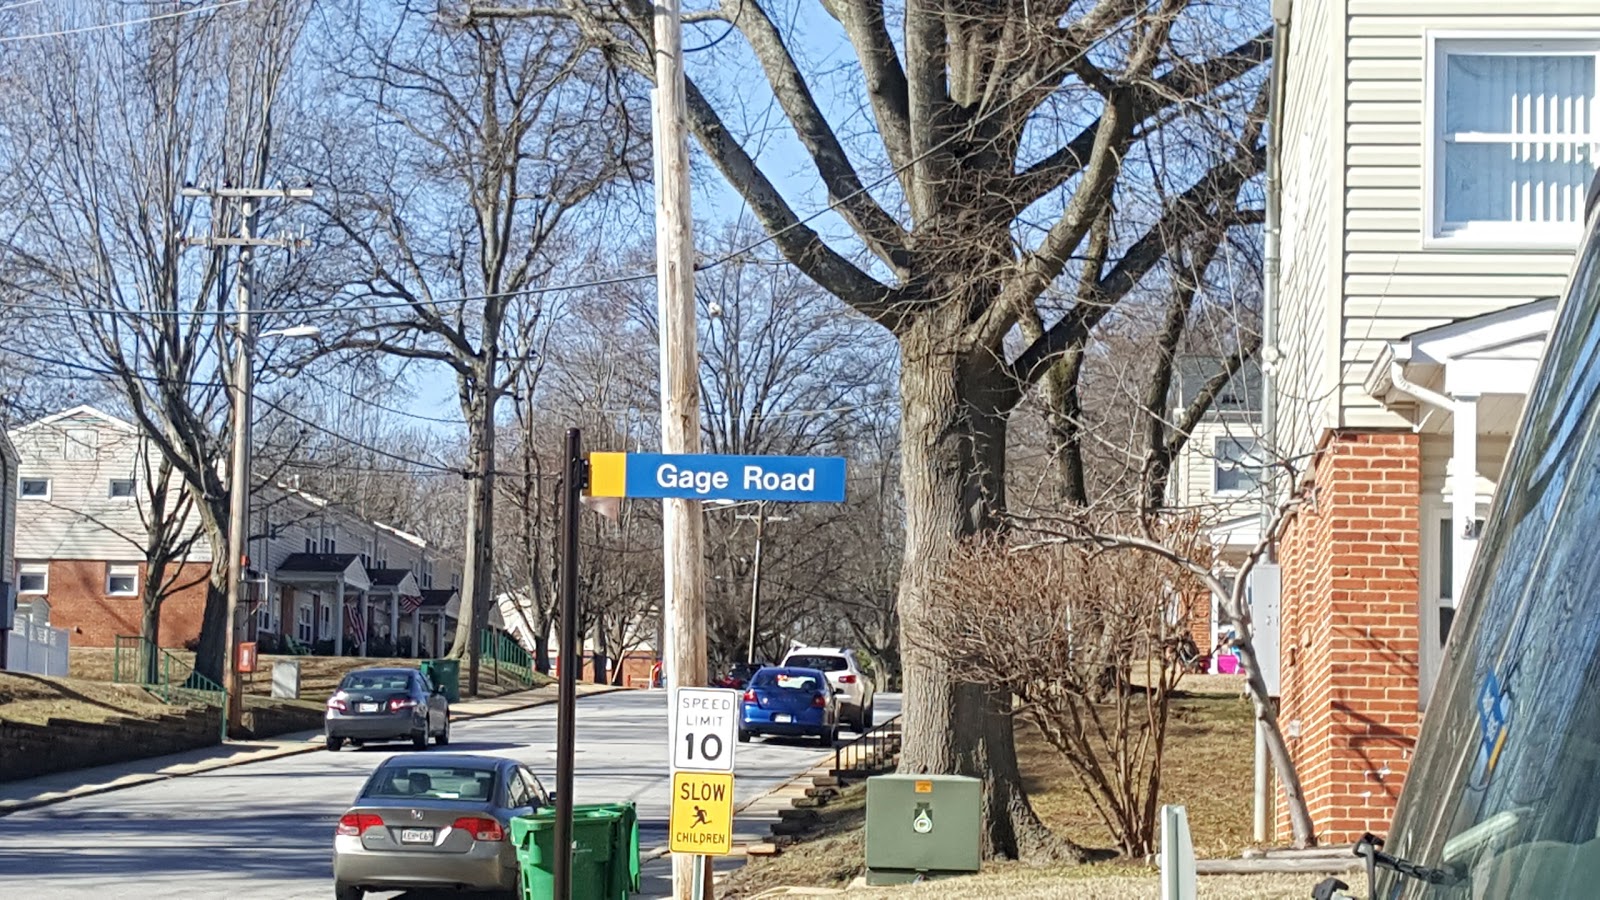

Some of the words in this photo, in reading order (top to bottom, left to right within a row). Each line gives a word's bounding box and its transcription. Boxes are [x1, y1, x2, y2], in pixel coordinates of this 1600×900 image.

[656, 463, 729, 493] Gage
[743, 465, 815, 491] Road
[682, 698, 731, 710] SPEED
[686, 716, 724, 727] LIMIT
[685, 732, 723, 761] 10
[681, 782, 726, 802] SLOW
[676, 832, 725, 844] CHILDREN
